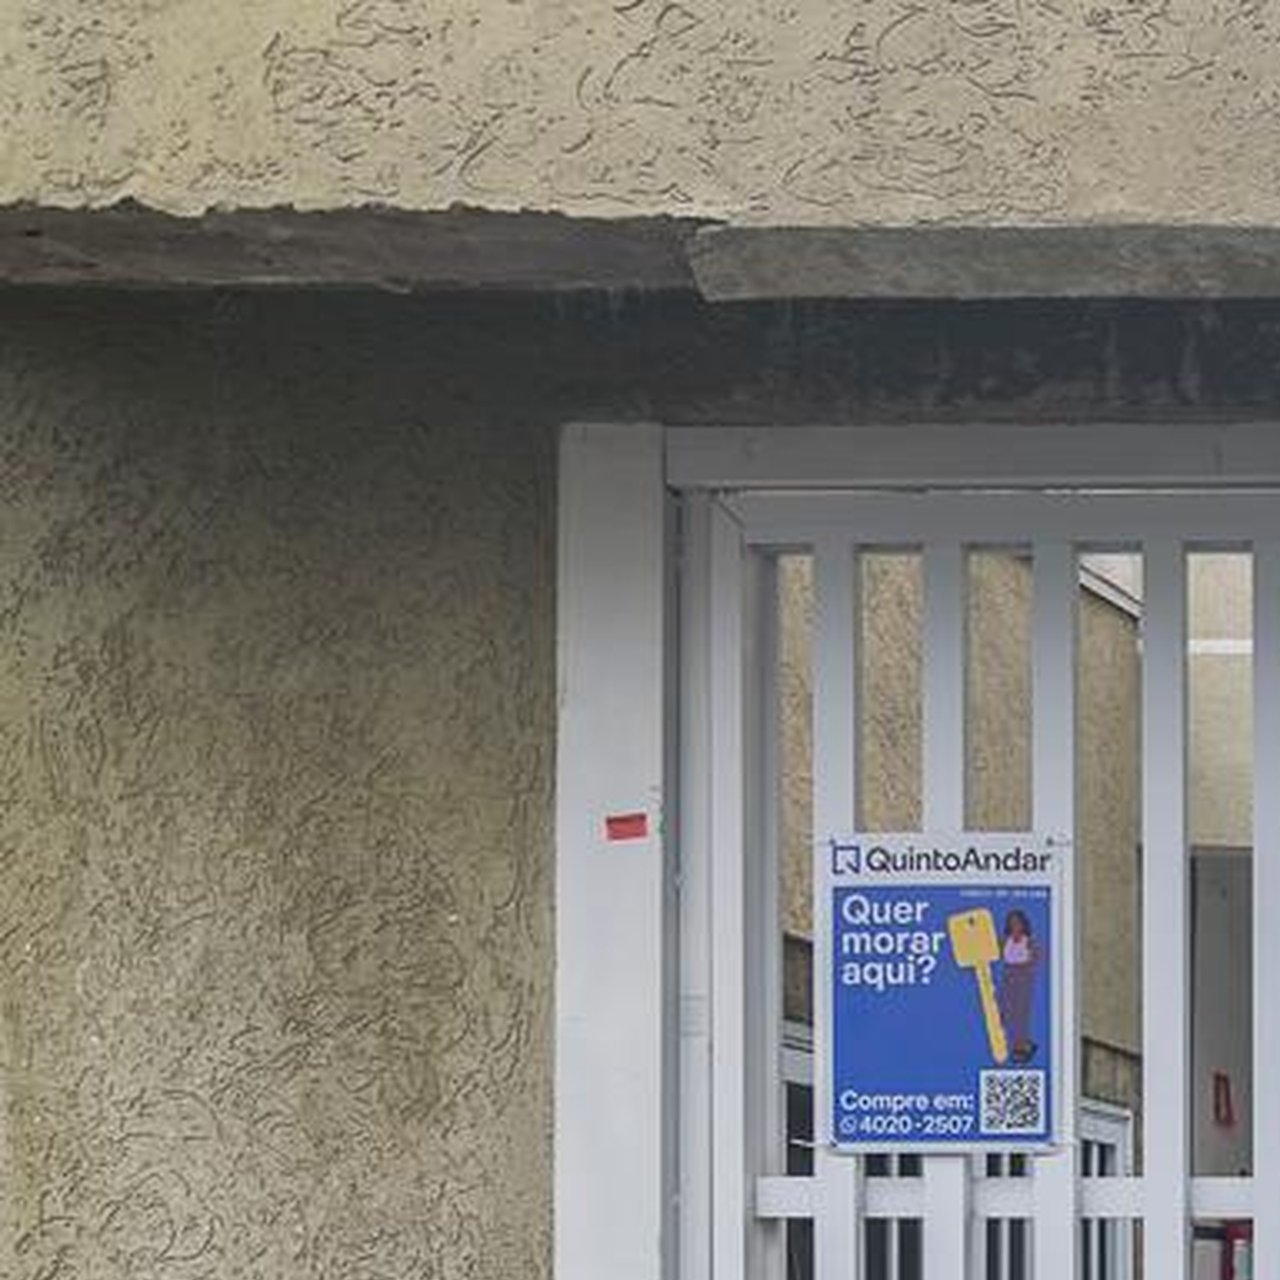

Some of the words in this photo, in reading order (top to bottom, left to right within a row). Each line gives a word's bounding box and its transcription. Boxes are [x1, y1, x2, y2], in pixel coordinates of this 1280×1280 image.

[865, 846, 1051, 875] QuintoAndar
[841, 893, 930, 926] Quer
[841, 930, 946, 954] morar
[841, 954, 937, 991] aqui?
[840, 1089, 930, 1114] Compre
[932, 1093, 975, 1111] em:
[859, 1114, 974, 1134] 4020-2507
